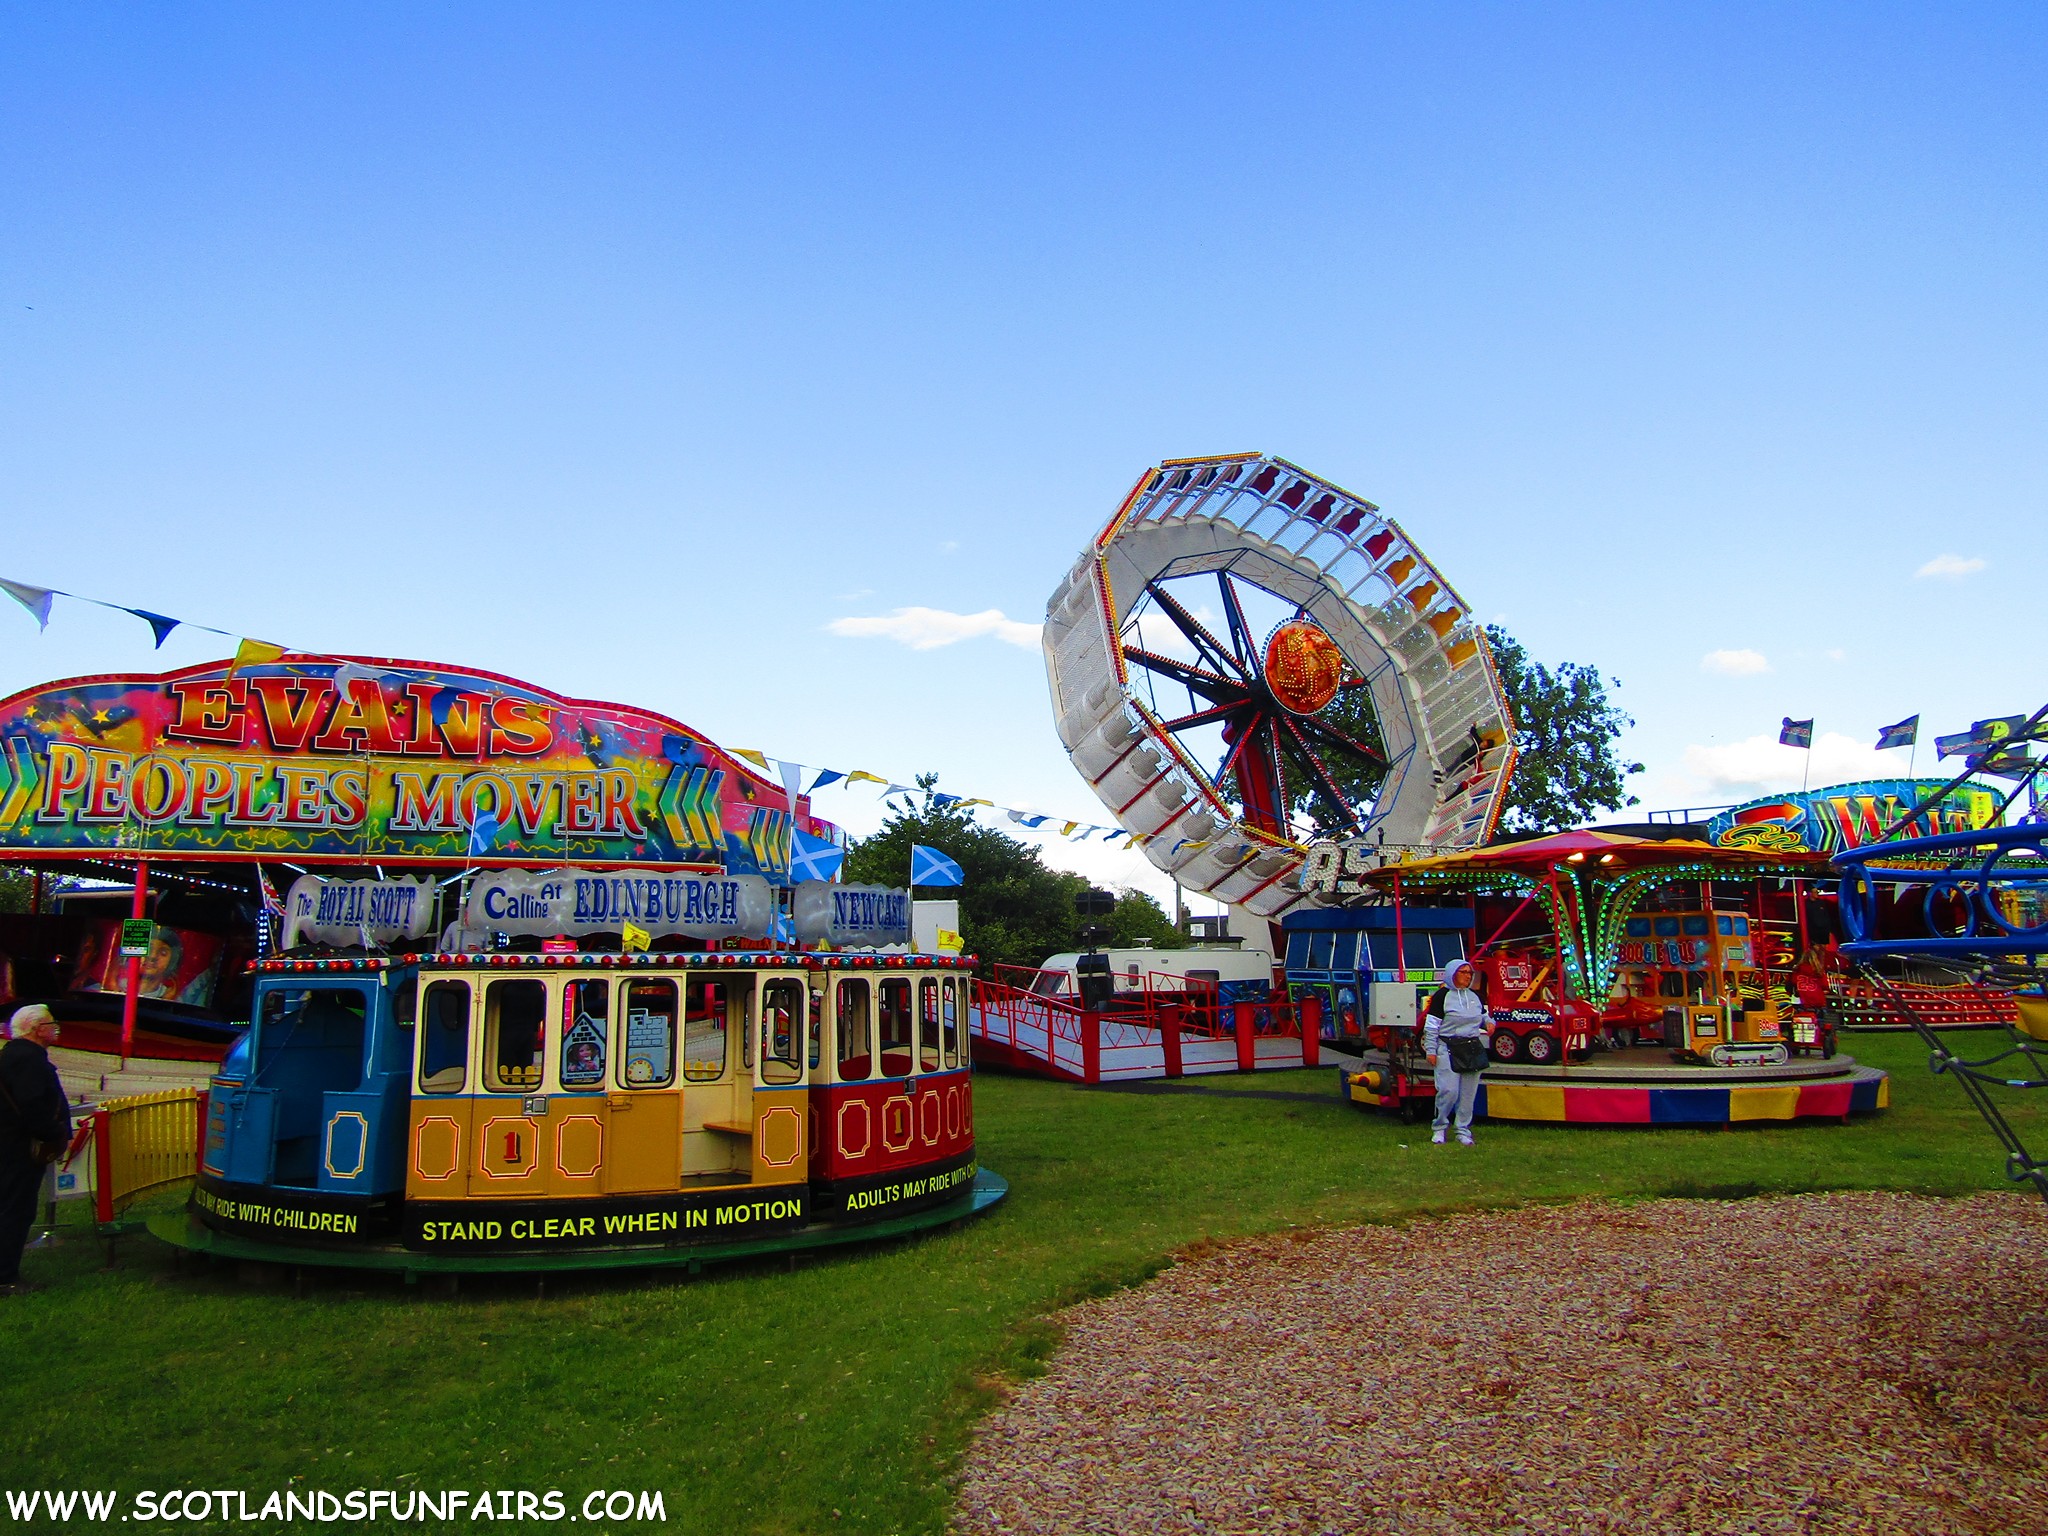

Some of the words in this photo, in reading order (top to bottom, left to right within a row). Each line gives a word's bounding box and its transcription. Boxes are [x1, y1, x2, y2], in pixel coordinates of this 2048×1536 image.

[168, 676, 554, 756] EVANS
[38, 741, 369, 830] PEOPLES
[390, 766, 648, 840] MOVER
[297, 893, 313, 917] The
[316, 886, 364, 926] ROYAL
[367, 886, 416, 929] SCOTT
[484, 886, 548, 920] Calling
[540, 883, 562, 900] At
[573, 878, 739, 925] EDINBURGH
[1618, 942, 1664, 964] BOOGIE
[1667, 941, 1696, 965] BUS
[1511, 1009, 1549, 1022] Recovery
[894, 1108, 903, 1135] 1
[503, 1131, 520, 1162] 1
[847, 1184, 900, 1212] ADULTS
[903, 1178, 927, 1200] MAY
[929, 1172, 950, 1193] RIDE
[950, 1165, 967, 1187] WITH
[216, 1199, 236, 1219] RIDE
[239, 1203, 271, 1225] WITH
[273, 1208, 358, 1234] CHILDREN
[422, 1220, 502, 1241] STAND
[510, 1217, 596, 1240] CLEAR
[604, 1211, 678, 1234] WHEN
[685, 1208, 708, 1228] IN
[715, 1199, 802, 1226] MOTION
